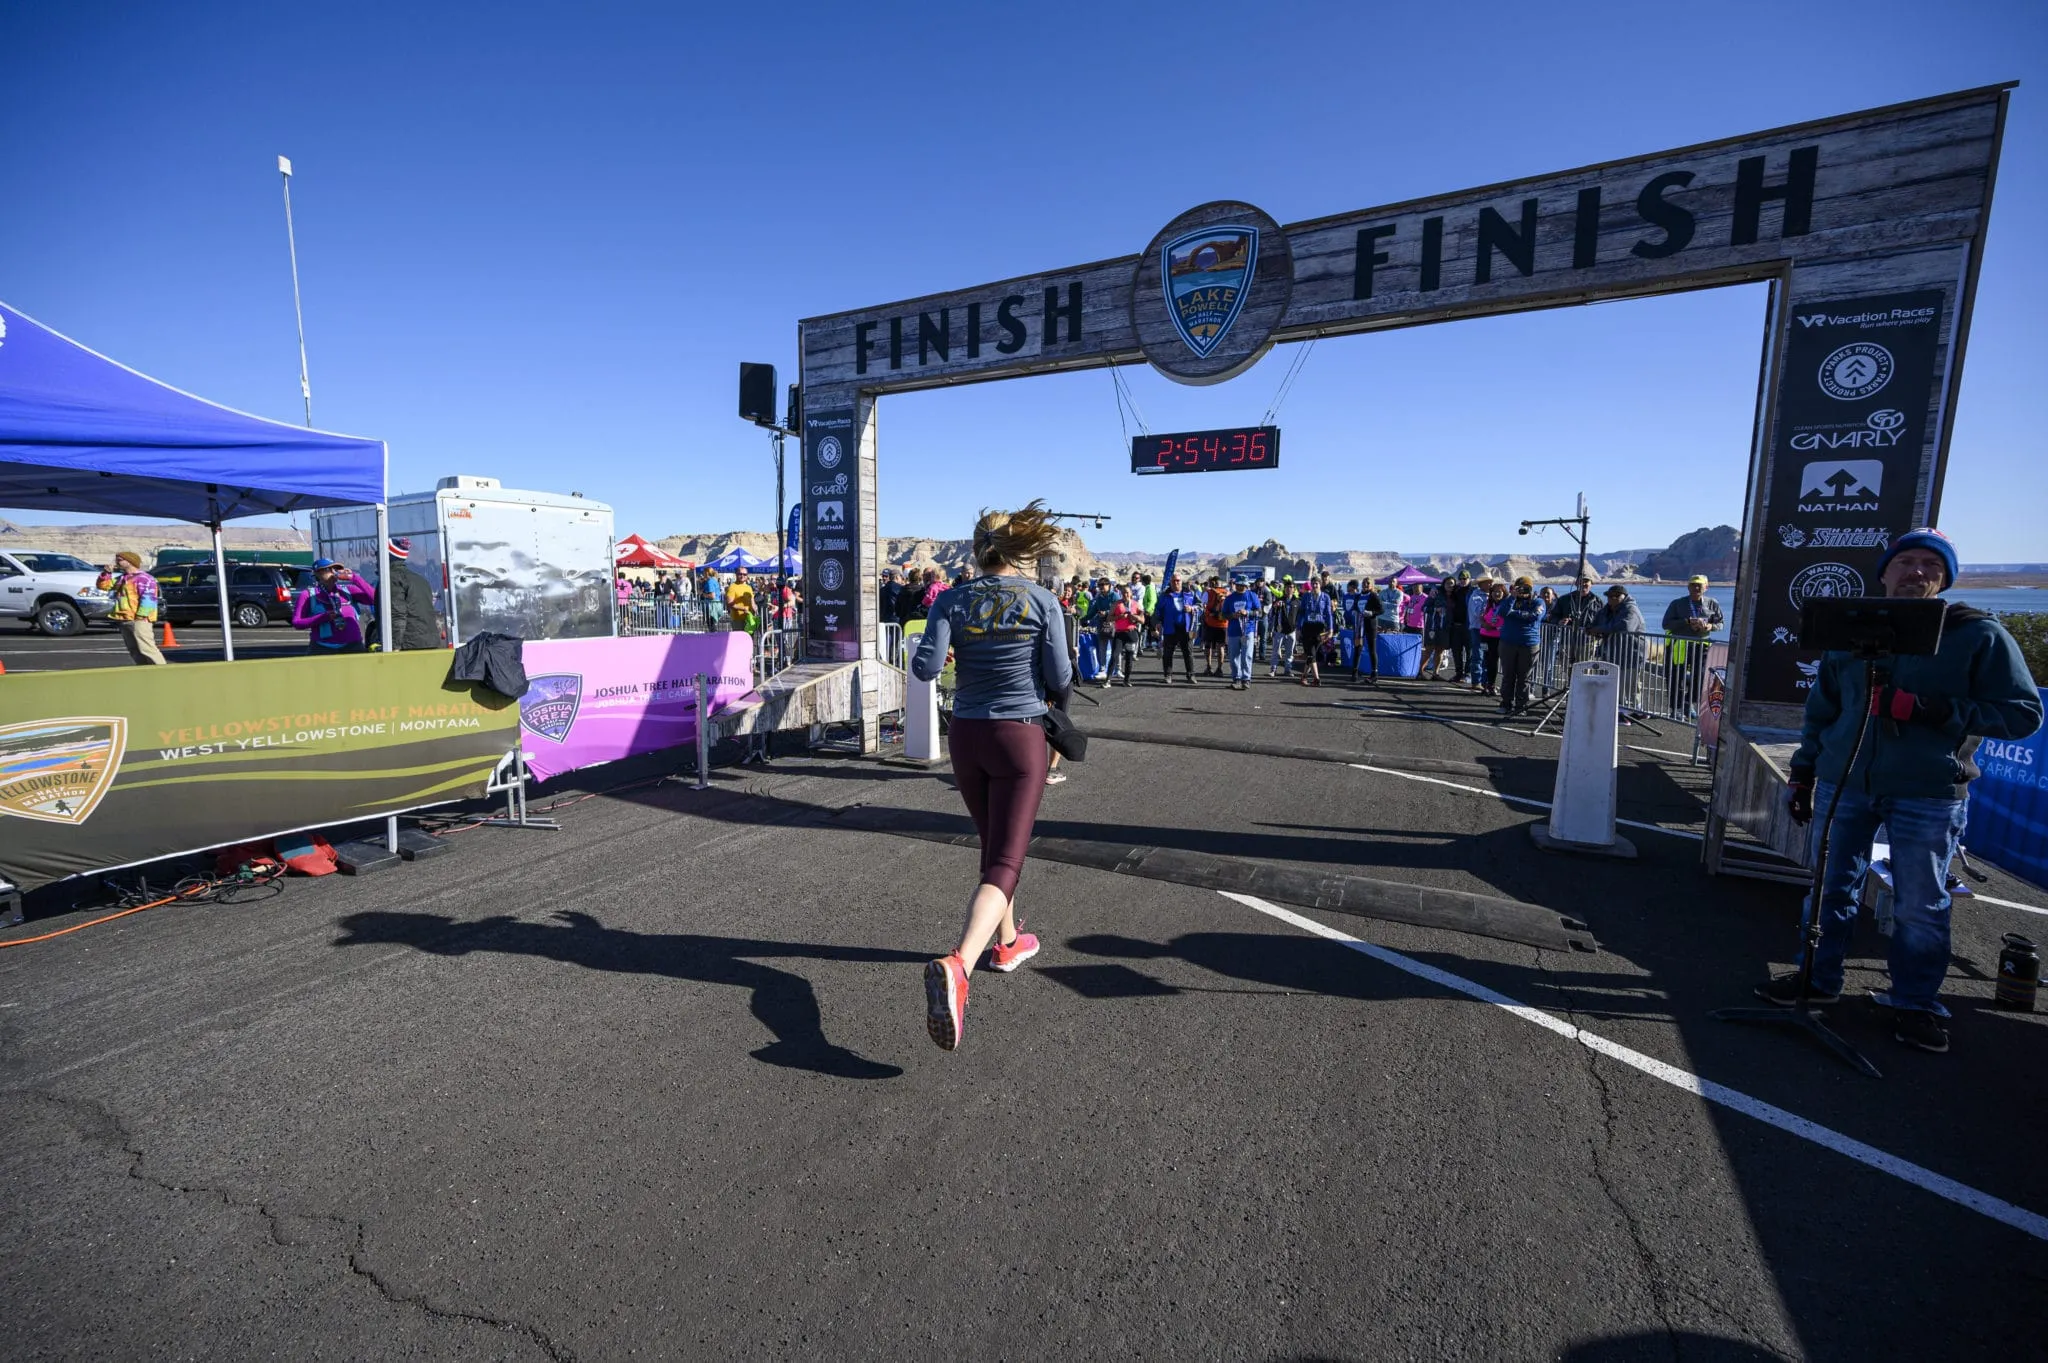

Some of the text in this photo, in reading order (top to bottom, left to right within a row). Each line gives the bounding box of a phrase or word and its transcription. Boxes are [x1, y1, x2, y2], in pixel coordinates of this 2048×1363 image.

[1354, 145, 1819, 299] FINISH
[1178, 288, 1236, 309] LAKE
[1181, 302, 1230, 319] POWELL
[1797, 307, 1935, 328] VR Vacation Races
[856, 281, 1082, 375] FINISH
[1188, 317, 1222, 327] MARATHON
[1825, 346, 1889, 370] PARKS PROJECT
[1823, 377, 1856, 397] PROJECT
[1859, 373, 1887, 394] PARKS
[1790, 429, 1906, 450] GNARLY
[811, 484, 848, 496] GNARLY
[1797, 502, 1879, 512] NATHAN
[1810, 530, 1889, 550] STINGER
[1806, 565, 1850, 577] WANDER
[593, 684, 639, 699] JOSHUA
[643, 680, 668, 692] TREE
[704, 676, 746, 687] ARATHON
[158, 698, 508, 745] YELLOWSTONE HALF MARATH
[528, 704, 572, 721] JOSHUA
[530, 711, 569, 727] TREE
[160, 718, 480, 760] WEST YELLOWSTONE MONTANA
[1984, 739, 2034, 765] RACES
[1977, 758, 2013, 779] PARK
[21, 789, 86, 808] MARATHON
[37, 786, 66, 797] HALF
